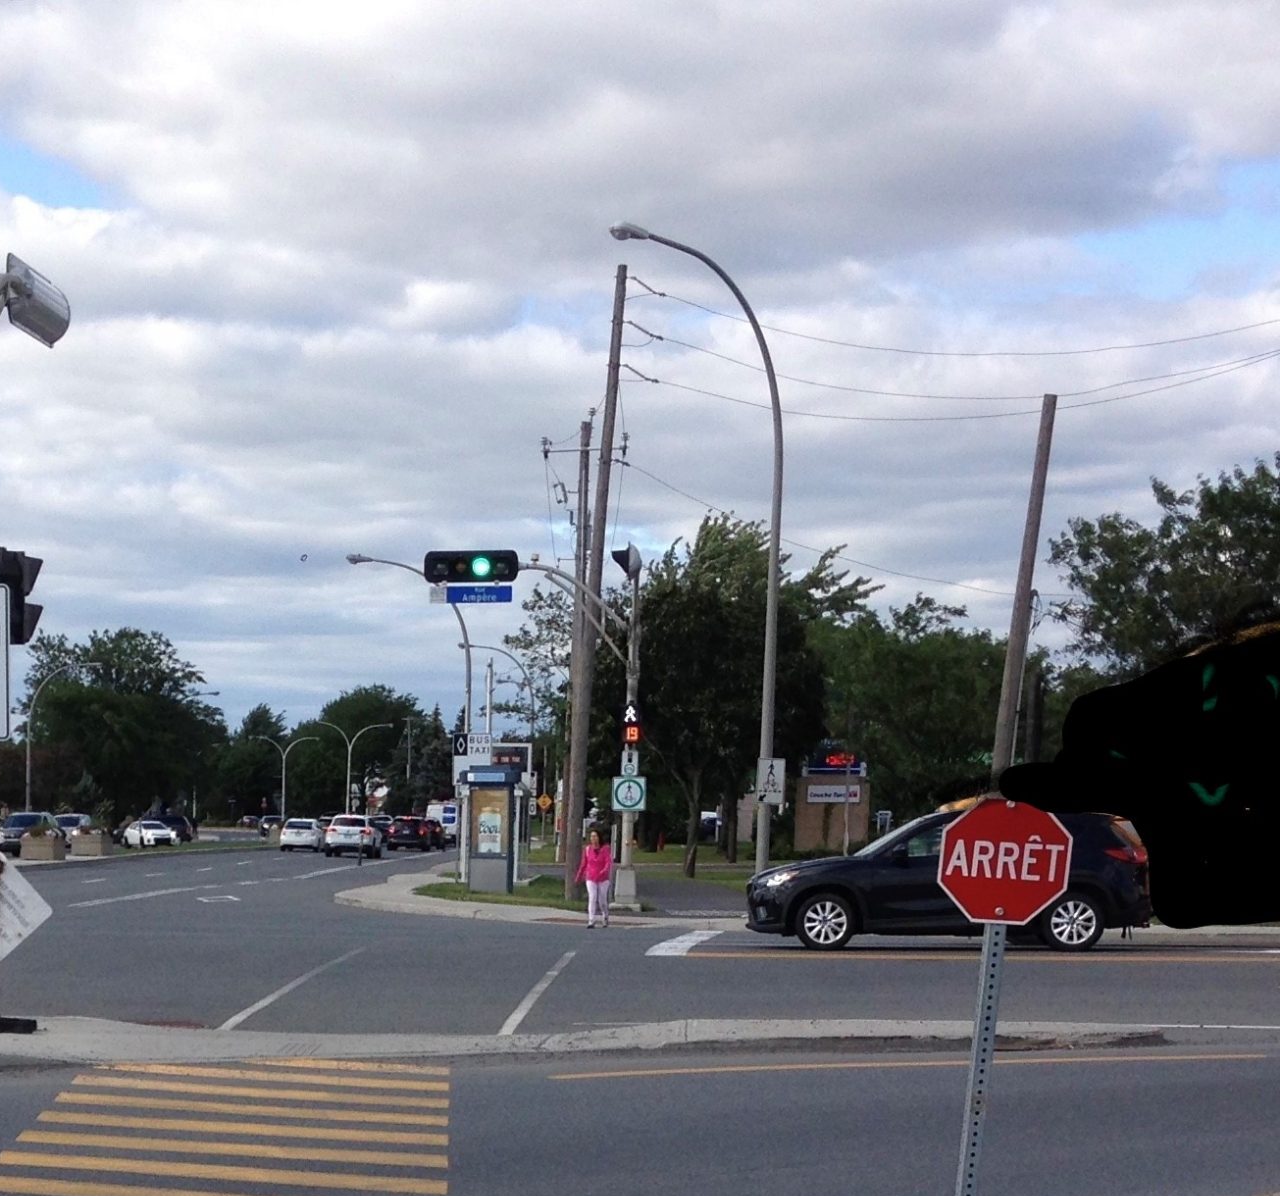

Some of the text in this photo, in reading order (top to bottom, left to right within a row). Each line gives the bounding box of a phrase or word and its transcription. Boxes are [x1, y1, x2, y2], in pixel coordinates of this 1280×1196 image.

[462, 593, 497, 603] Ampère
[469, 735, 490, 744] BUS
[469, 746, 490, 754] TAXI
[945, 835, 1065, 882] ARRÊT
